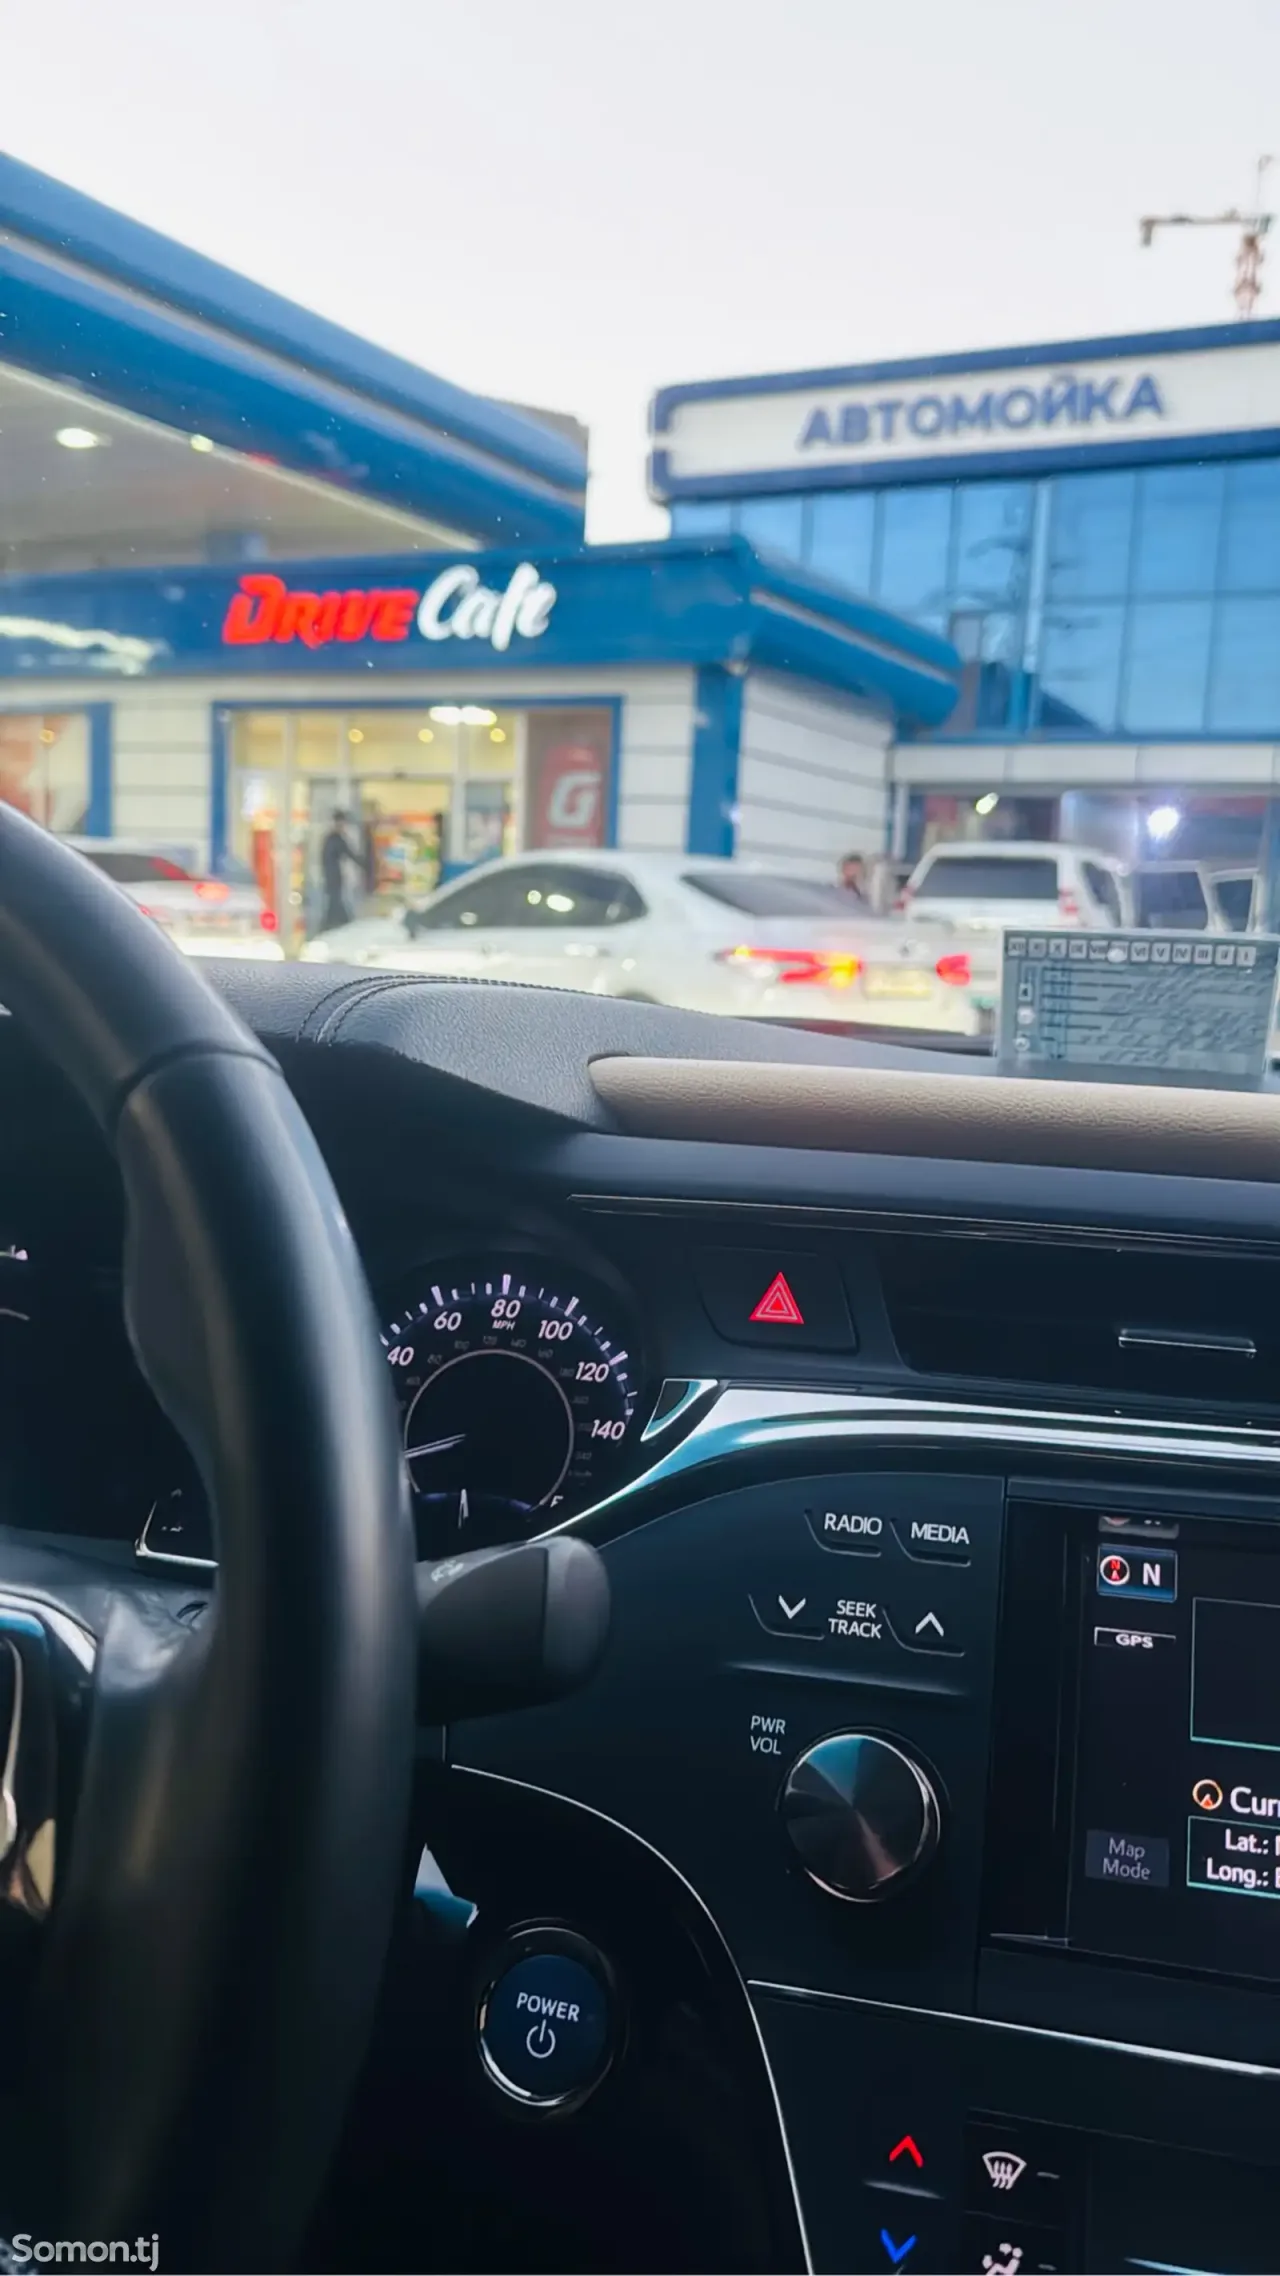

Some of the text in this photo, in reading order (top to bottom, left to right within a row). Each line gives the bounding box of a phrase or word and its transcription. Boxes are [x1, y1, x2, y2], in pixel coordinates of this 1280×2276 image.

[796, 374, 1164, 447] АВТОМОЙКА
[417, 562, 557, 651] Cafe
[490, 1299, 521, 1319] 80
[433, 1311, 462, 1331] 60
[492, 1319, 516, 1331] MPH
[537, 1320, 573, 1341] 100
[387, 1346, 414, 1366] 40
[575, 1361, 609, 1382] 120
[591, 1419, 626, 1440] 140
[550, 1495, 564, 1508] F
[823, 1512, 883, 1535] RADIO
[910, 1521, 970, 1545] MEDIA
[1142, 1562, 1161, 1587] N
[836, 1599, 877, 1619] SEEK
[828, 1618, 883, 1639] TRACK
[1115, 1633, 1154, 1649] GPS
[750, 1715, 786, 1735] PWR
[750, 1735, 782, 1755] VOL
[1108, 1836, 1146, 1862] Map
[1225, 1827, 1269, 1855] Lat.:
[1102, 1857, 1151, 1880] Mode
[1206, 1856, 1269, 1889] Long.:
[516, 1991, 581, 2022] POWER
